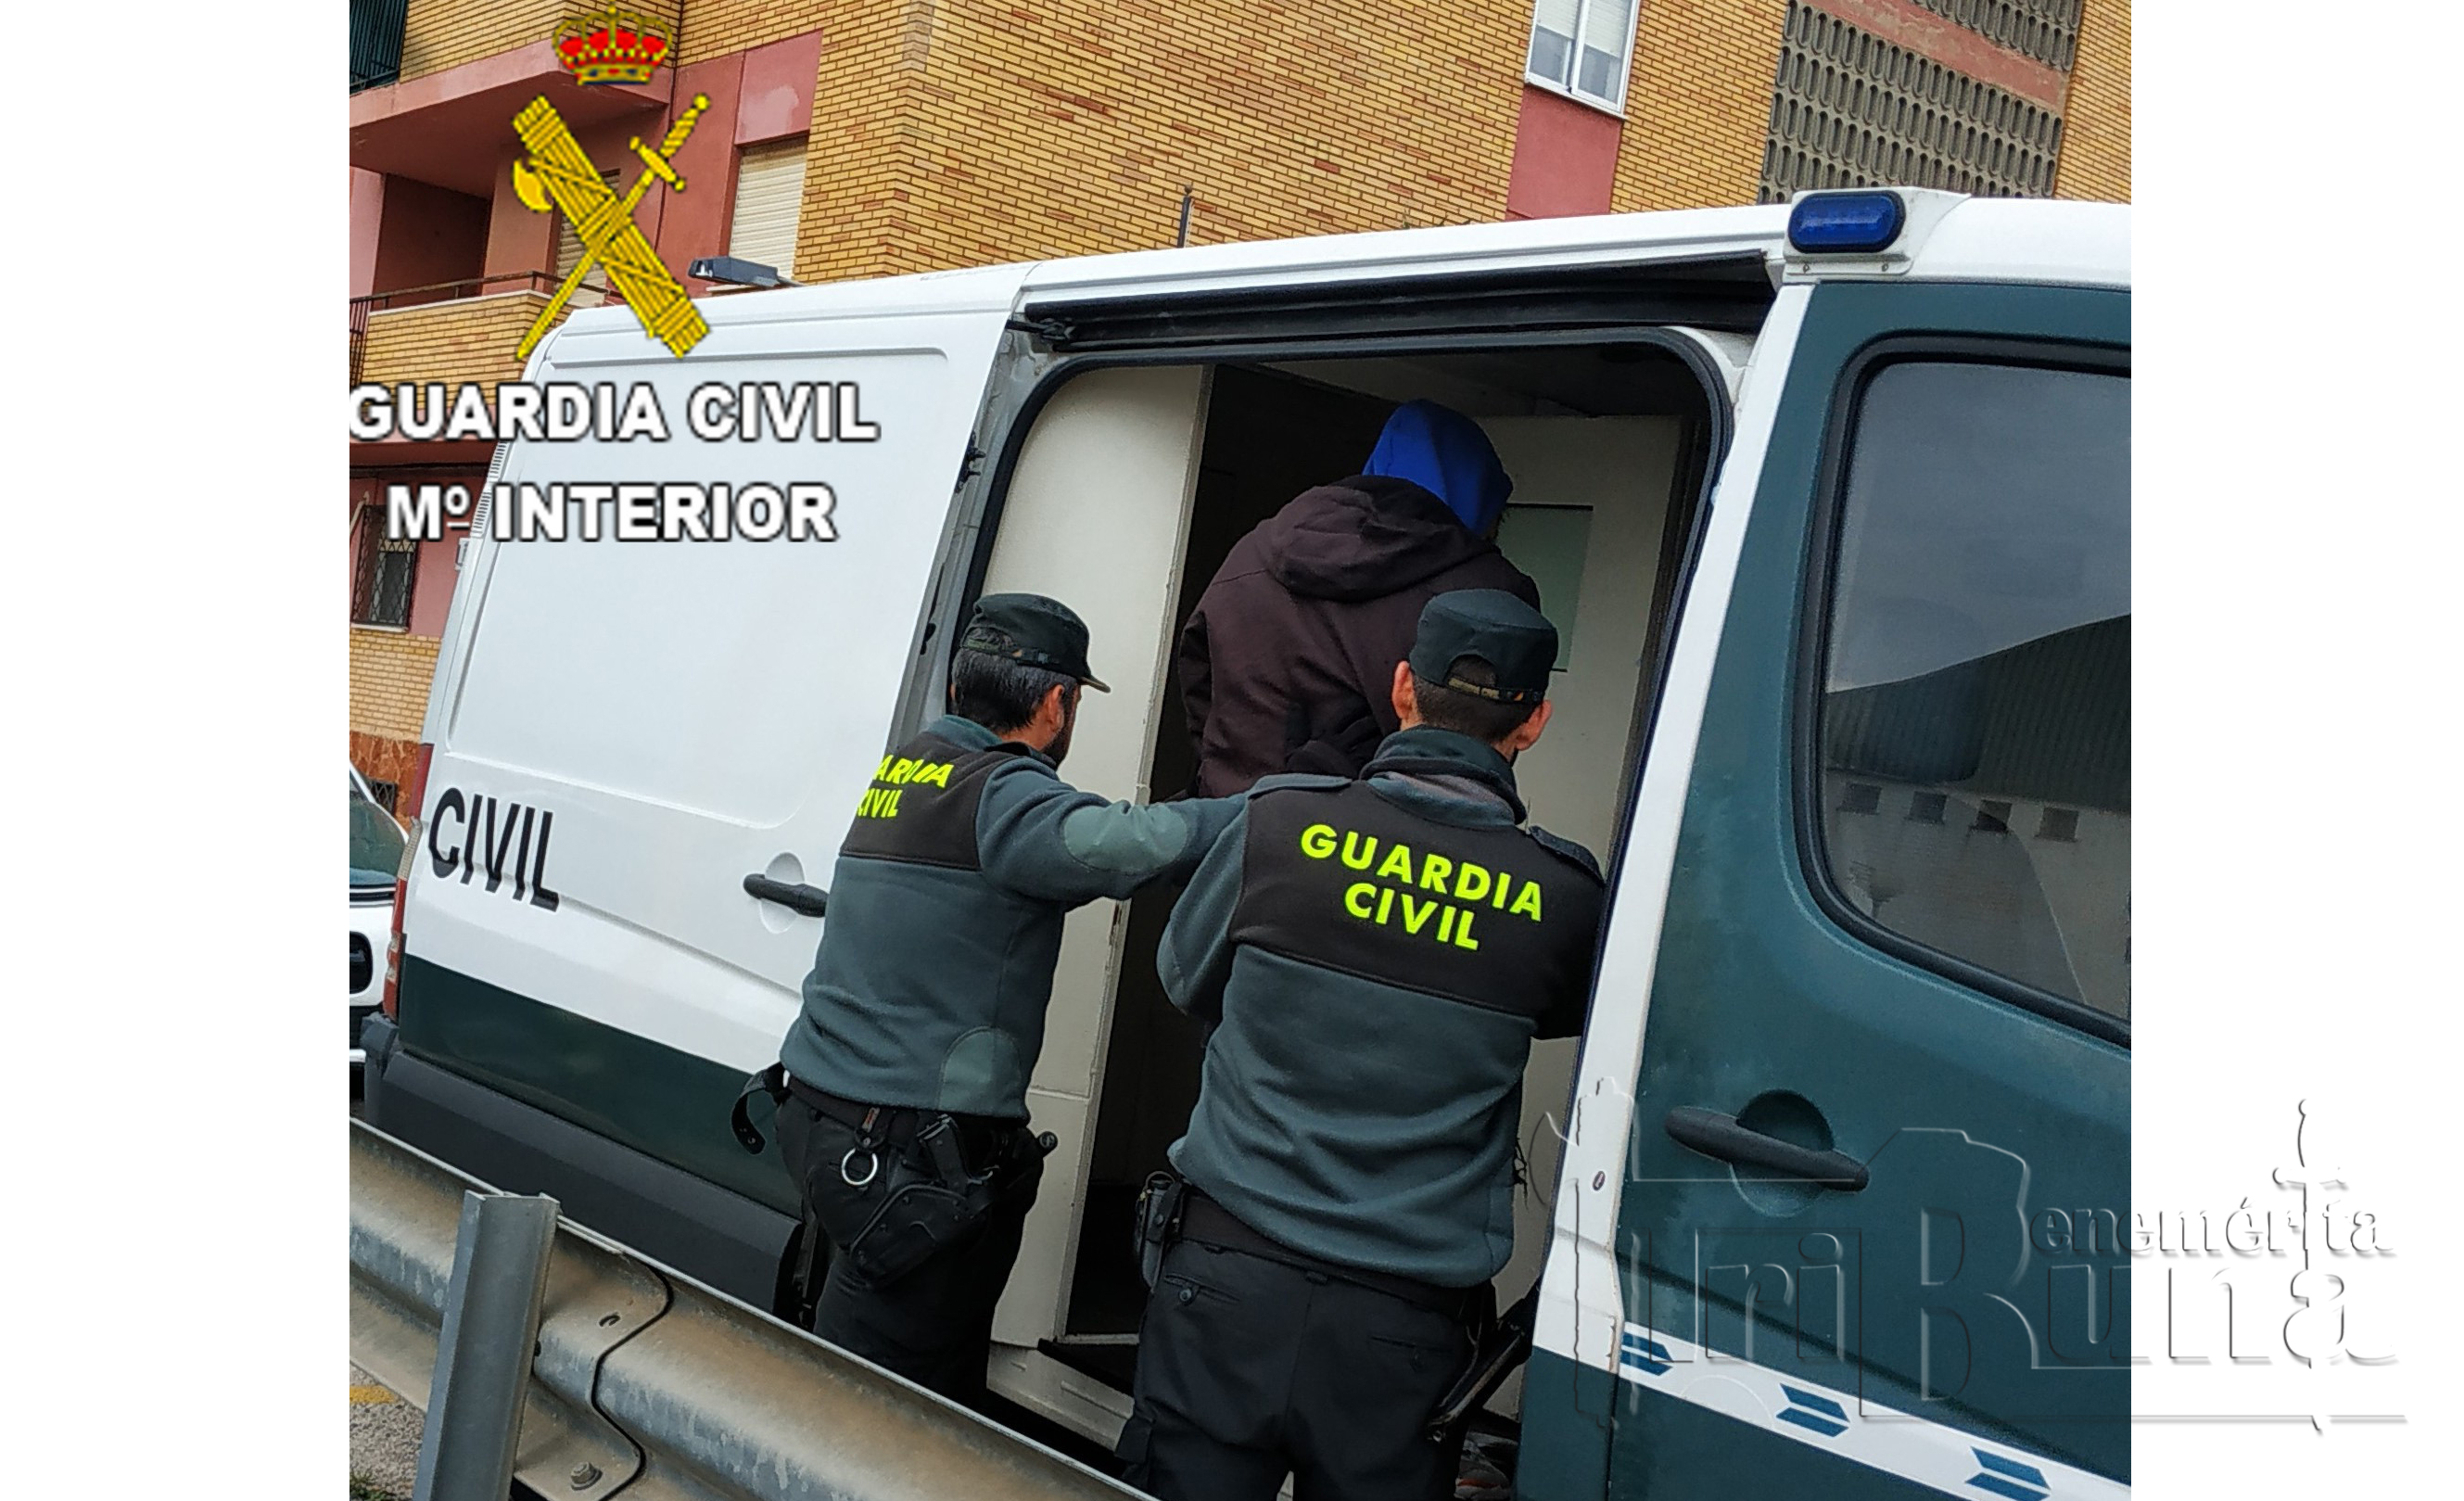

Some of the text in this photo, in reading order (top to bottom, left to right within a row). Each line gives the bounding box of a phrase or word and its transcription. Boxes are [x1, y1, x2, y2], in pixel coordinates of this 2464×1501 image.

[874, 754, 954, 788] ARDIA
[428, 787, 560, 912] CIVIL
[1301, 824, 1542, 922] GUARDIA
[1344, 883, 1479, 950] CIVIL
